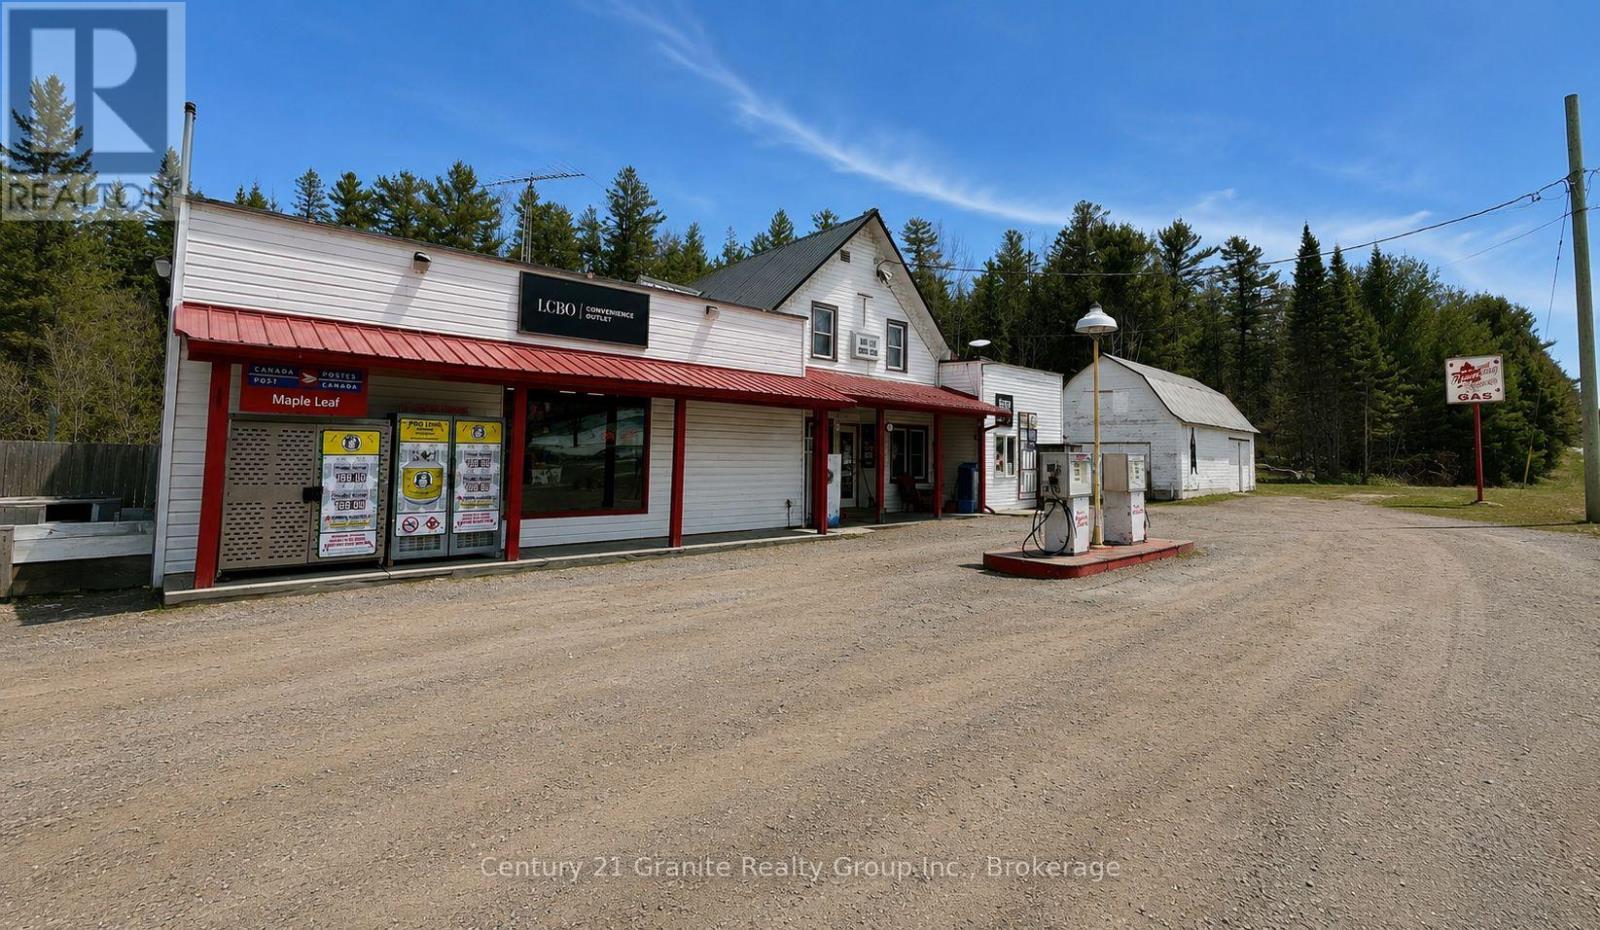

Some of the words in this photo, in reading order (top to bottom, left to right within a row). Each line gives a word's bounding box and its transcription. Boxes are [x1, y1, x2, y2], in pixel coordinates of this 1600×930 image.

[537, 298, 576, 317] LCBO
[585, 305, 634, 319] CONVENIENCE
[585, 313, 612, 323] OUTLET
[254, 366, 294, 375] CANADA
[322, 382, 357, 390] CANADA
[272, 393, 311, 408] Maple
[314, 396, 341, 408] Leaf
[1457, 392, 1493, 401] GAS
